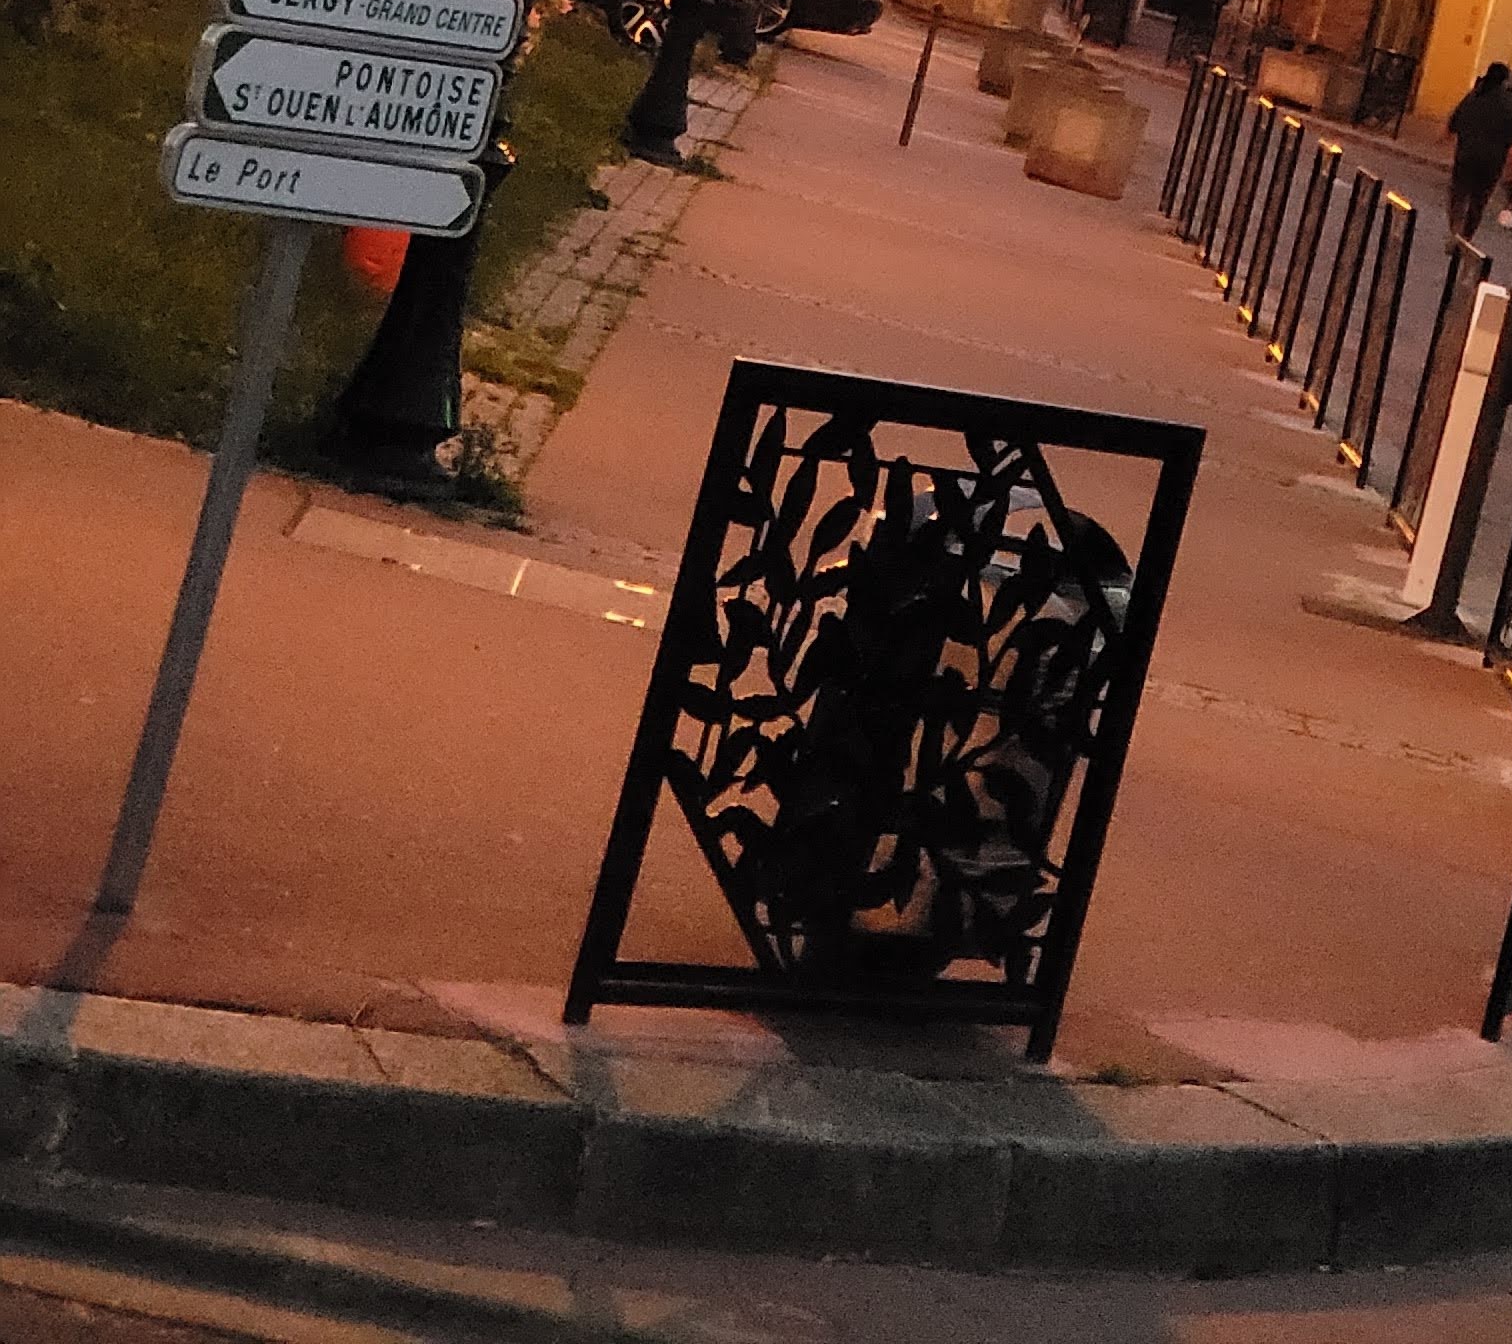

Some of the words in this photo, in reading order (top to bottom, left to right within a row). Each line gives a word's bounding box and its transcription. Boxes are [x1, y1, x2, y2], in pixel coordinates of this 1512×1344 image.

[435, 7, 507, 39] CENTRE
[335, 59, 486, 108] PONTOISE
[266, 86, 341, 125] OUEN
[187, 151, 221, 184] Le
[236, 157, 302, 195] Port
